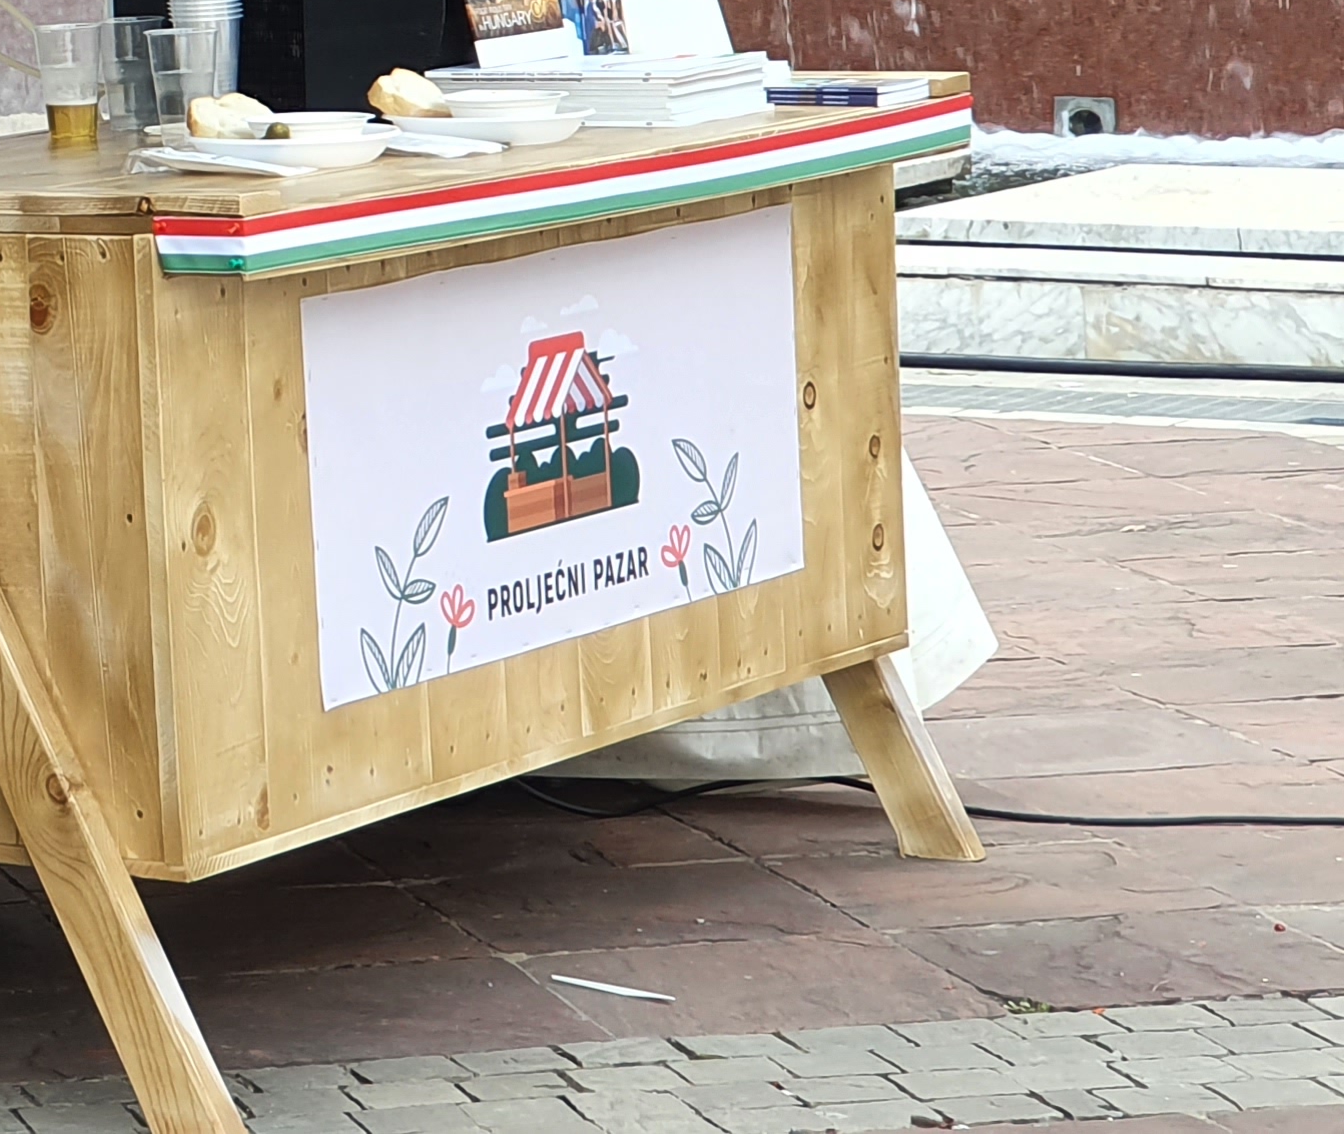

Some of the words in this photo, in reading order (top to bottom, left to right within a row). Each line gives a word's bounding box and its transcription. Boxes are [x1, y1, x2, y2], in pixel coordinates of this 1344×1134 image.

[482, 10, 533, 30] HUNGARY
[487, 559, 586, 621] PROLJEĆNI
[593, 546, 650, 591] PAZAR
